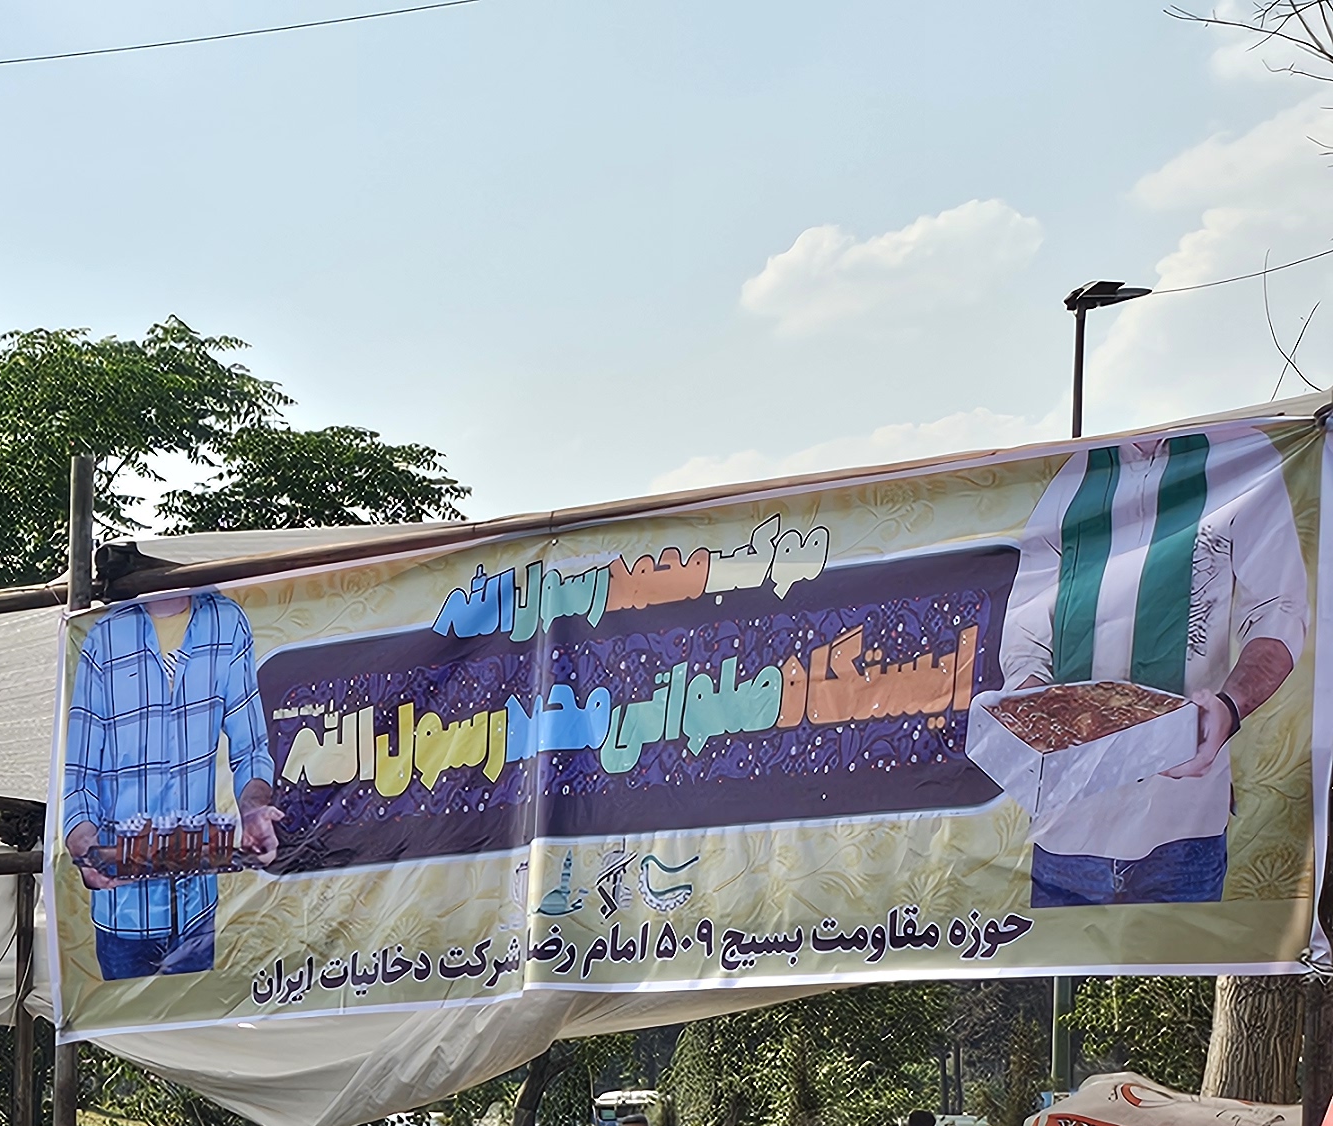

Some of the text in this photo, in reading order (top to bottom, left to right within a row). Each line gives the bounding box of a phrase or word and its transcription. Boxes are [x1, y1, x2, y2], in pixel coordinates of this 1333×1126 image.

[431, 513, 830, 643] موکب محمد رسول الله
[281, 624, 979, 797] ایستگاه صلواتی محمد رسول الله
[580, 920, 651, 980] امام
[654, 916, 715, 962] ۵۰۹
[719, 923, 804, 972] بسیج
[810, 903, 941, 964] مقاومت
[947, 906, 1035, 961] حوزه
[252, 955, 314, 1006] ایران
[319, 942, 434, 997] دخانیات
[438, 936, 523, 988] شرکت
